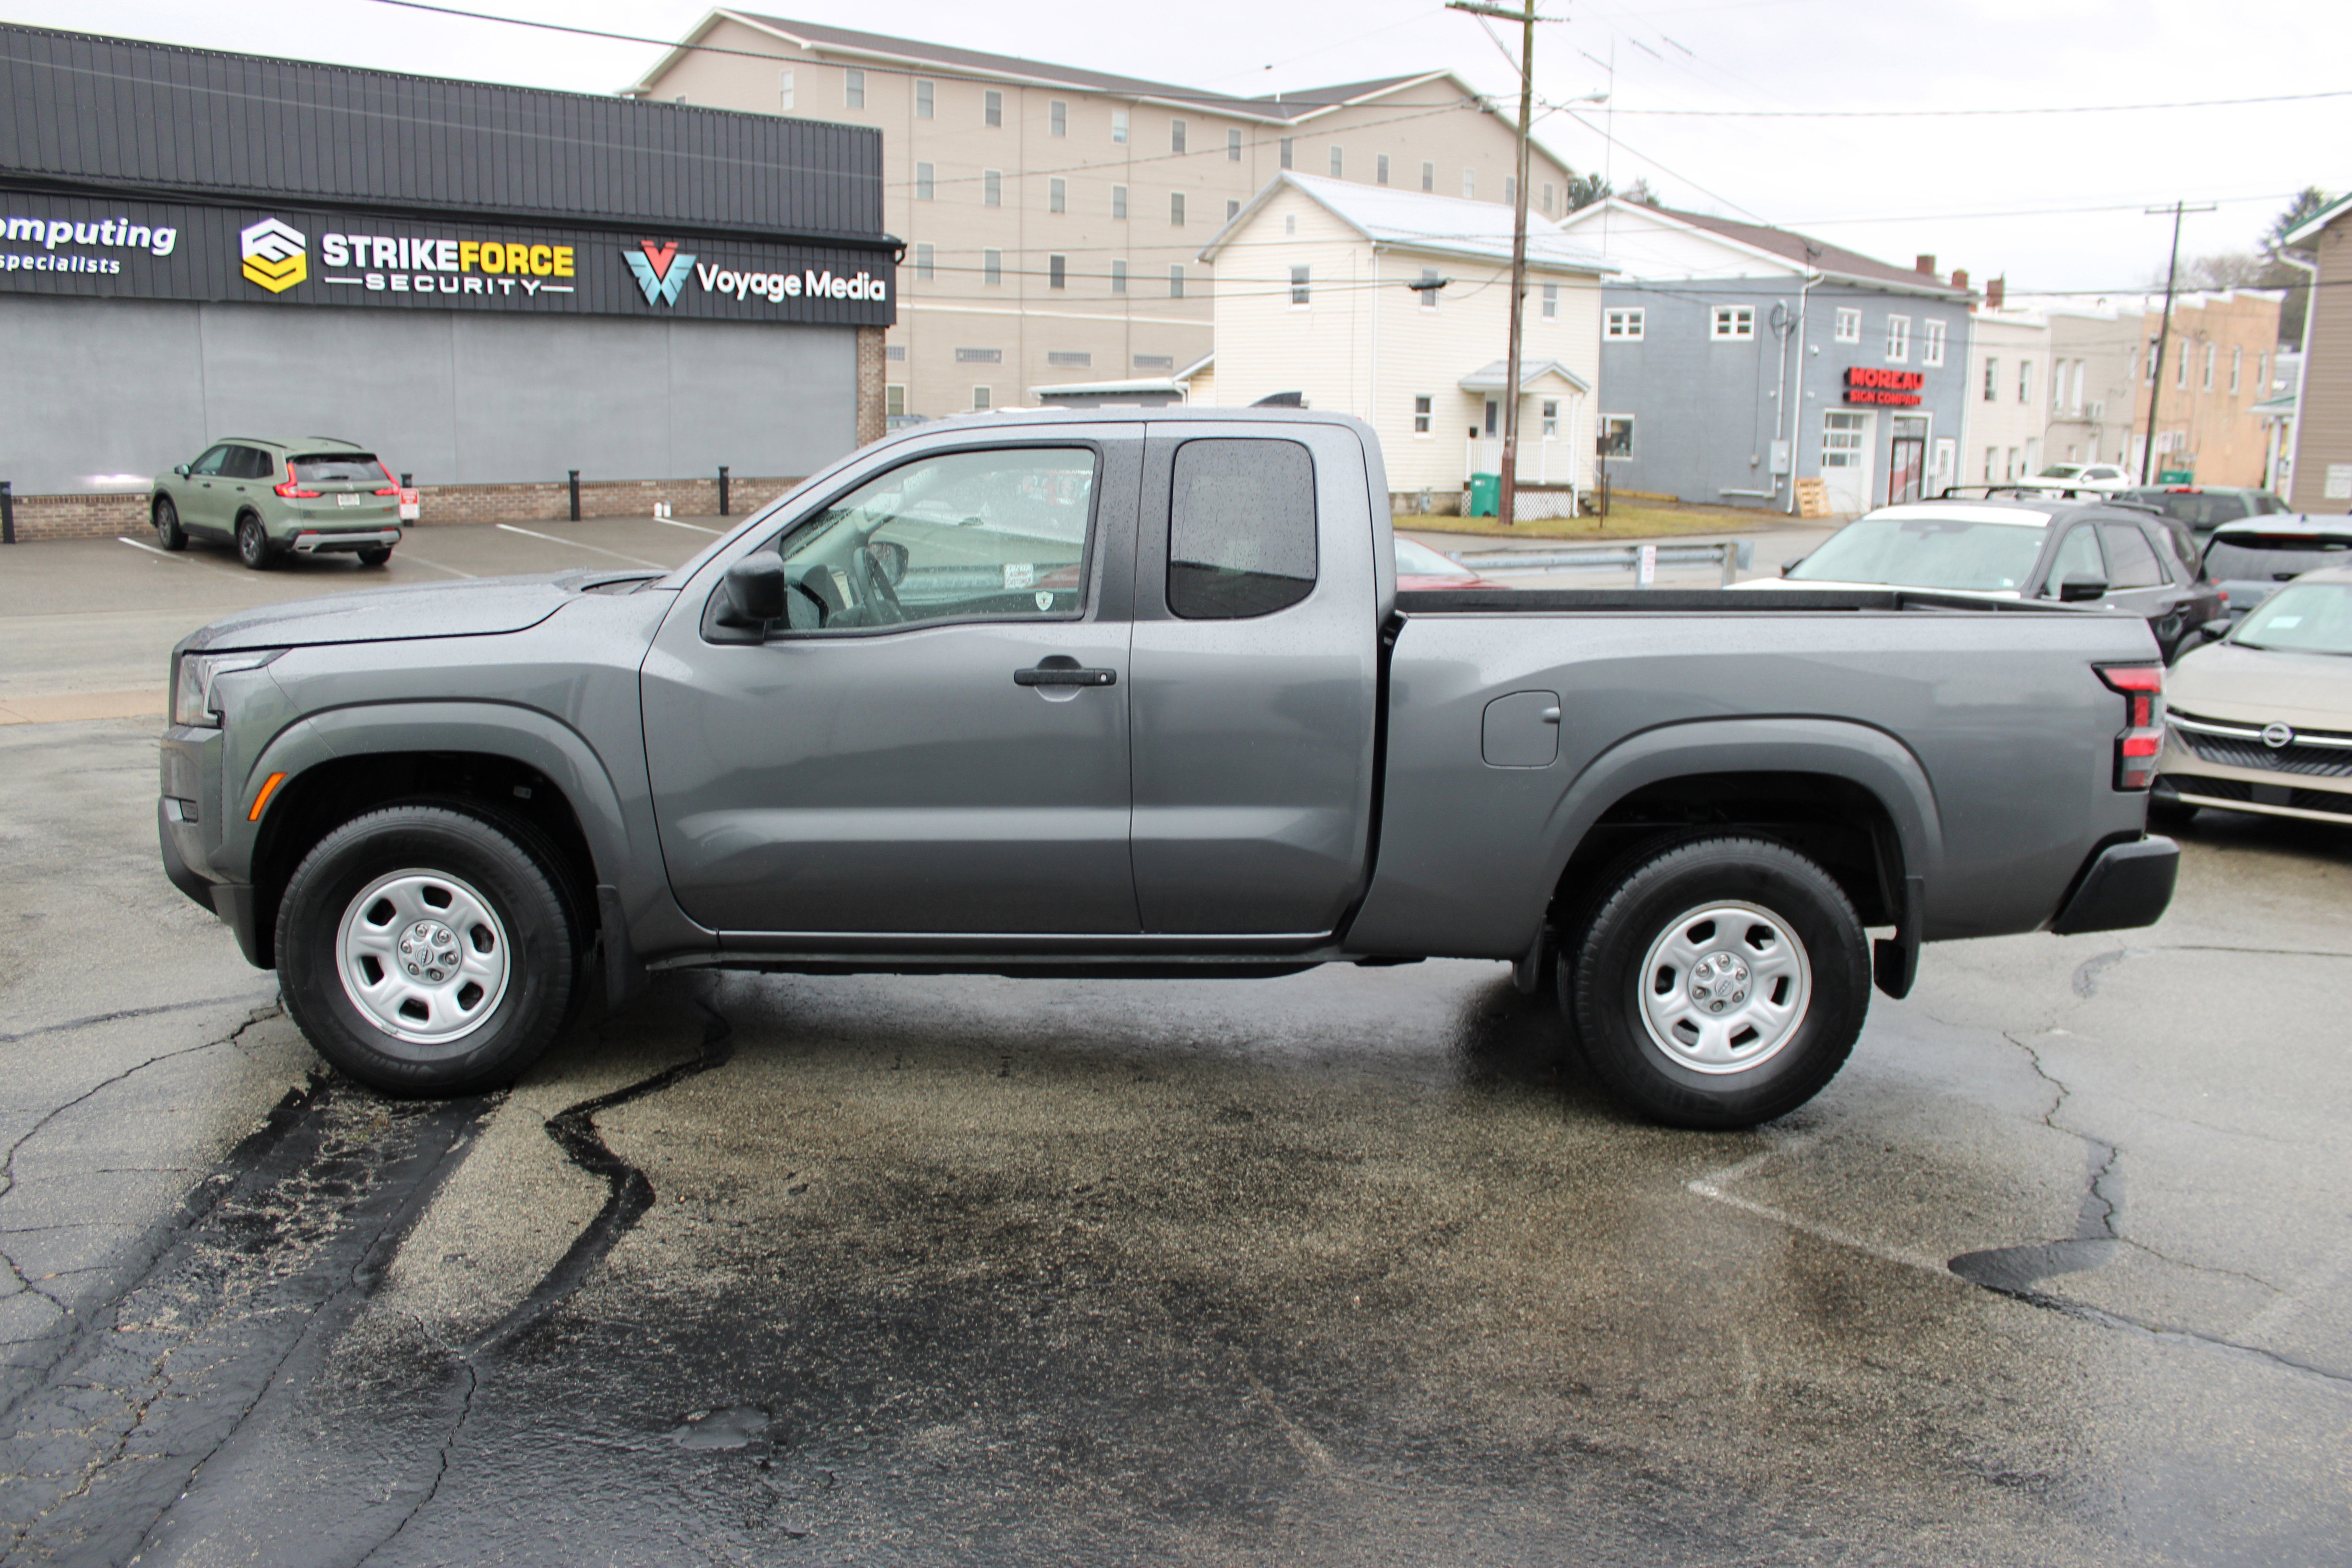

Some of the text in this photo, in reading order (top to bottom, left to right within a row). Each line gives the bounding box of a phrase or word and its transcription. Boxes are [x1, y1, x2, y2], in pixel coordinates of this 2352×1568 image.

[323, 233, 574, 276] STRIKEFORCE
[365, 273, 541, 296] SECURITY
[697, 262, 886, 303] Voyage Media
[1851, 366, 1924, 390] MOREAU
[1850, 390, 1923, 406] SIGN COMPANY
